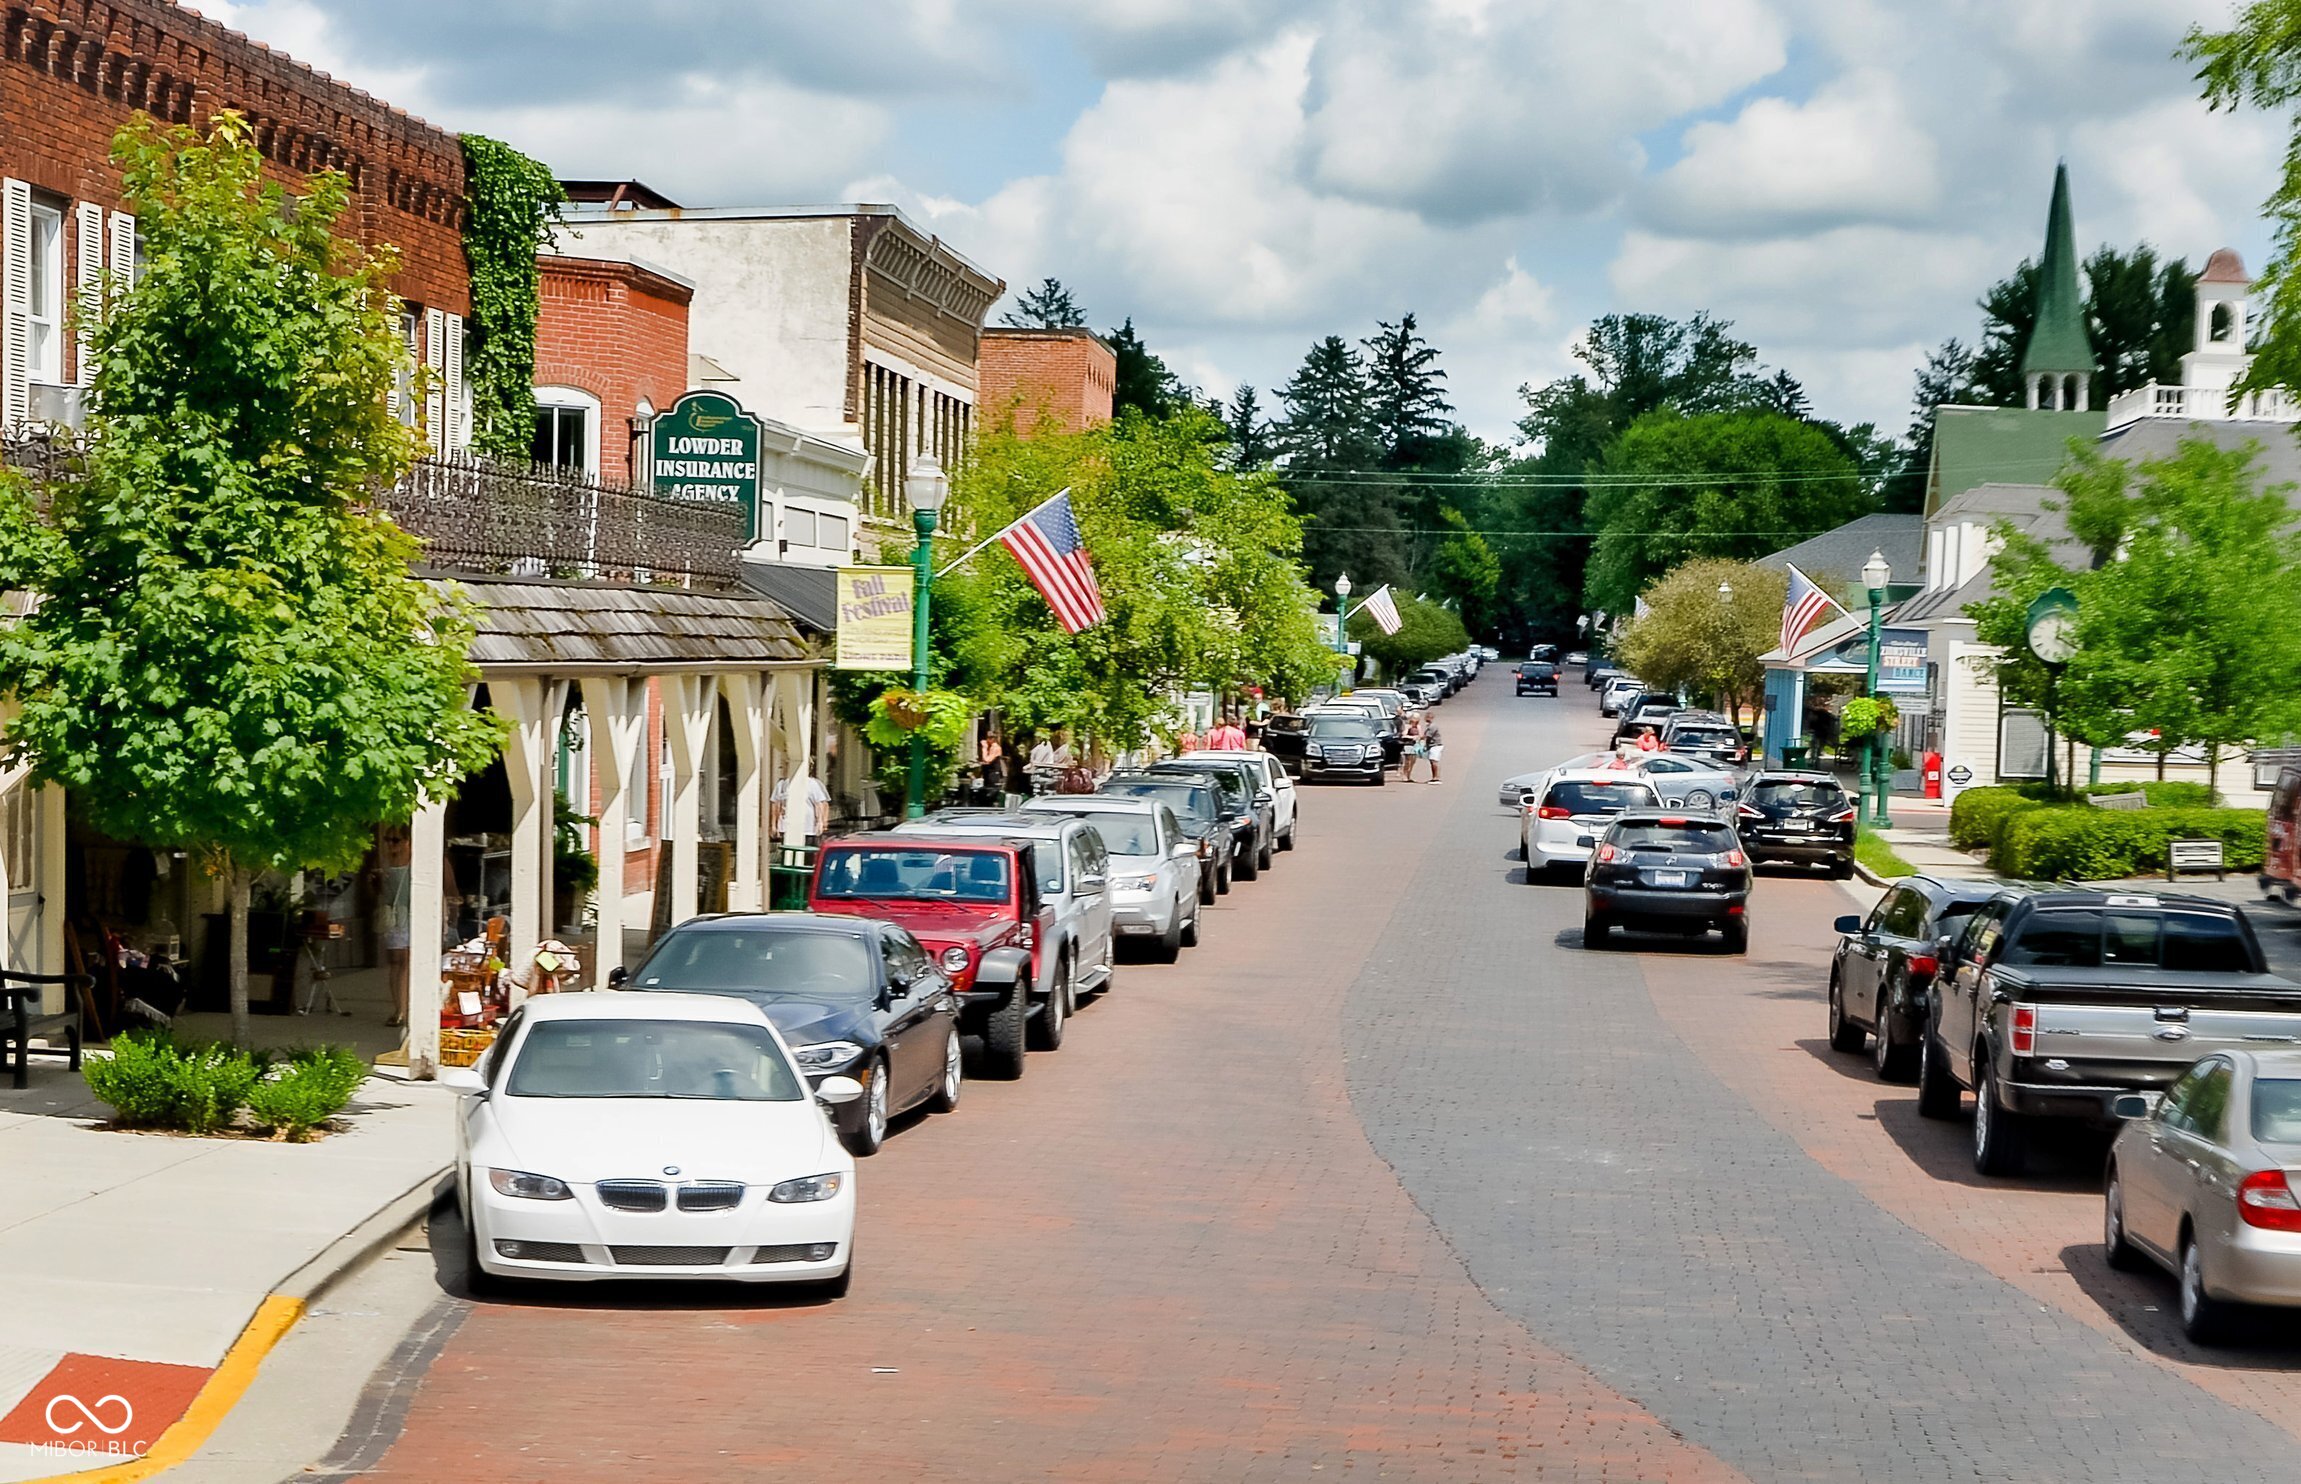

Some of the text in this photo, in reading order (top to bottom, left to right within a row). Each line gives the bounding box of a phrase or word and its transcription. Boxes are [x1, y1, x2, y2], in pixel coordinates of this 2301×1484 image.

[668, 436, 744, 456] LOWDER
[655, 459, 756, 480] INSURANCE
[670, 483, 741, 502] AGENCY
[852, 573, 886, 599] Fall
